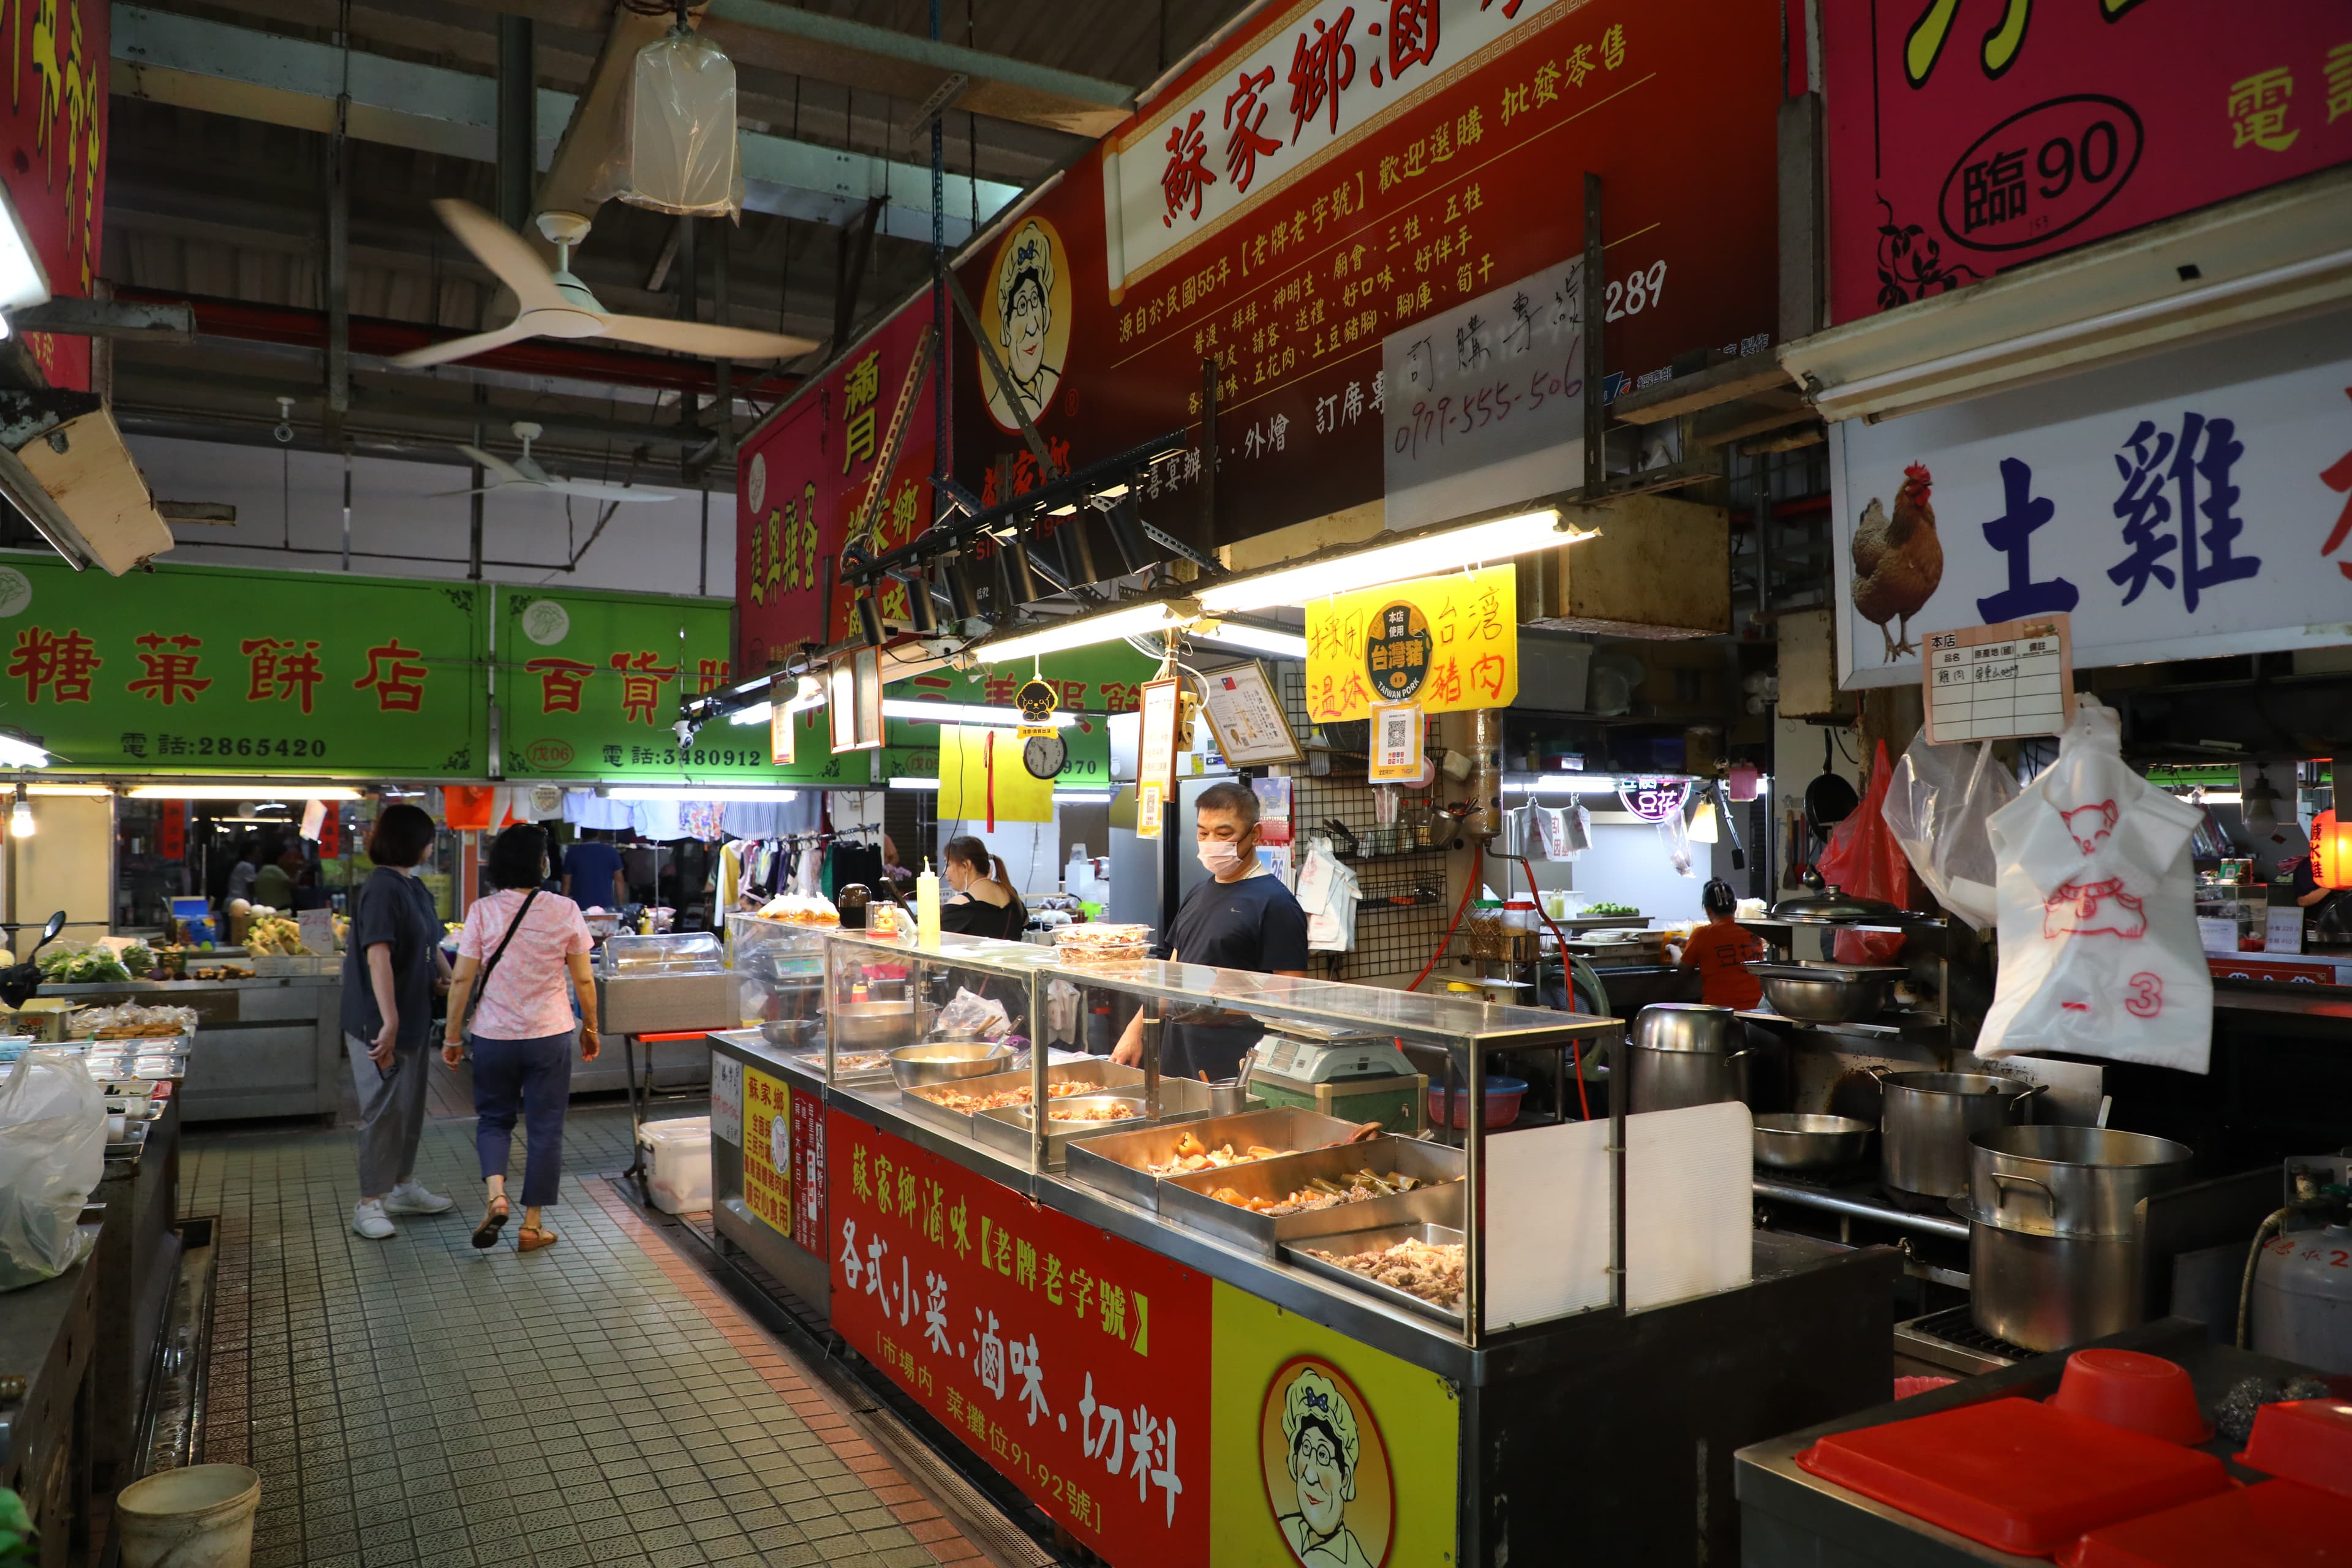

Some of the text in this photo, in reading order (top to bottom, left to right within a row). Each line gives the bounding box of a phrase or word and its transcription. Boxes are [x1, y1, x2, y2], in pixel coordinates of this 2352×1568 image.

[1501, 24, 1627, 127] 批發零售
[1163, 0, 1525, 229] 蘇家鄉滷
[1964, 121, 2119, 235] 臨90
[843, 349, 880, 475] 滿月
[1395, 336, 1583, 459] 0979-555-506
[1977, 412, 2261, 624] 土雞
[1389, 609, 1404, 623] 本店
[1389, 624, 1404, 638] 使用
[1371, 639, 1424, 672] 台灣豬
[1931, 633, 1956, 649] 本店
[8, 626, 429, 715] 糖菓餅店
[1944, 653, 1961, 663] 品名
[1378, 676, 1420, 699] TAIWAN PORK
[121, 732, 327, 759] 電話:2865420
[601, 744, 761, 767] 電話:3480912
[1638, 790, 1678, 815] 豆花
[748, 1076, 785, 1115] 蘇家鄉
